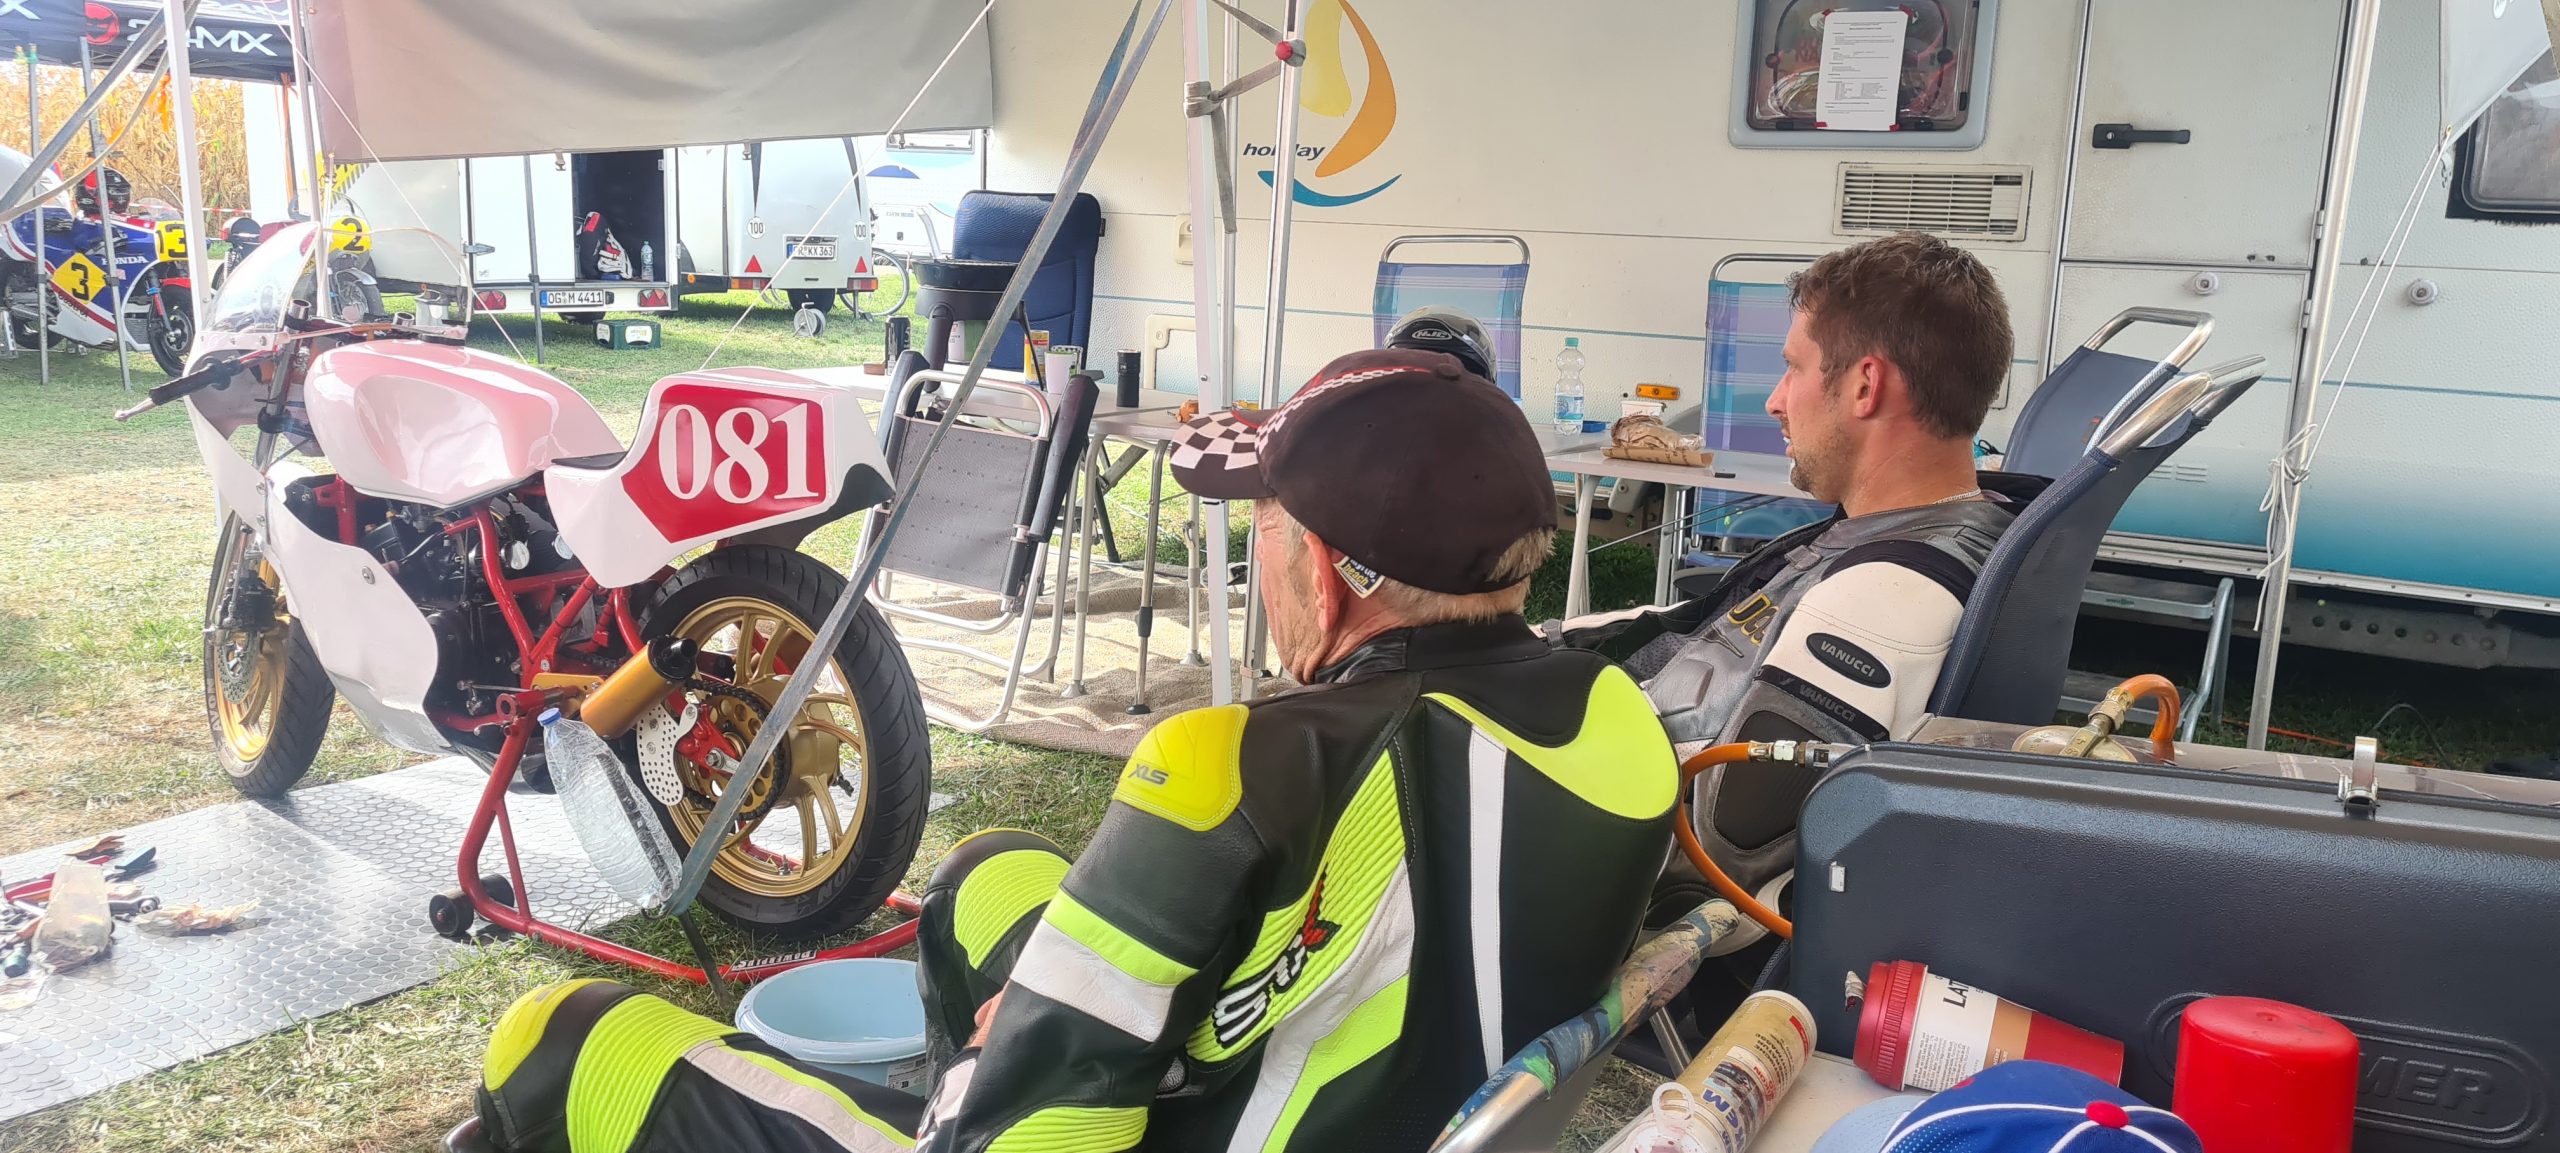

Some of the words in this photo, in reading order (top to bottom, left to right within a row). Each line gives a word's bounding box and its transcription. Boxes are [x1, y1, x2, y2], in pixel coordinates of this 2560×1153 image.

[1242, 143, 1326, 161] holay
[341, 218, 364, 251] 2
[750, 222, 764, 234] 100
[854, 226, 867, 238] 100
[819, 246, 833, 256] 363
[71, 262, 90, 301] 3
[577, 292, 603, 303] 4411
[658, 403, 819, 504] 081
[1820, 640, 1876, 678] VANUCCI
[1799, 683, 1856, 721] VANUCCI
[1127, 763, 1169, 786] XLS
